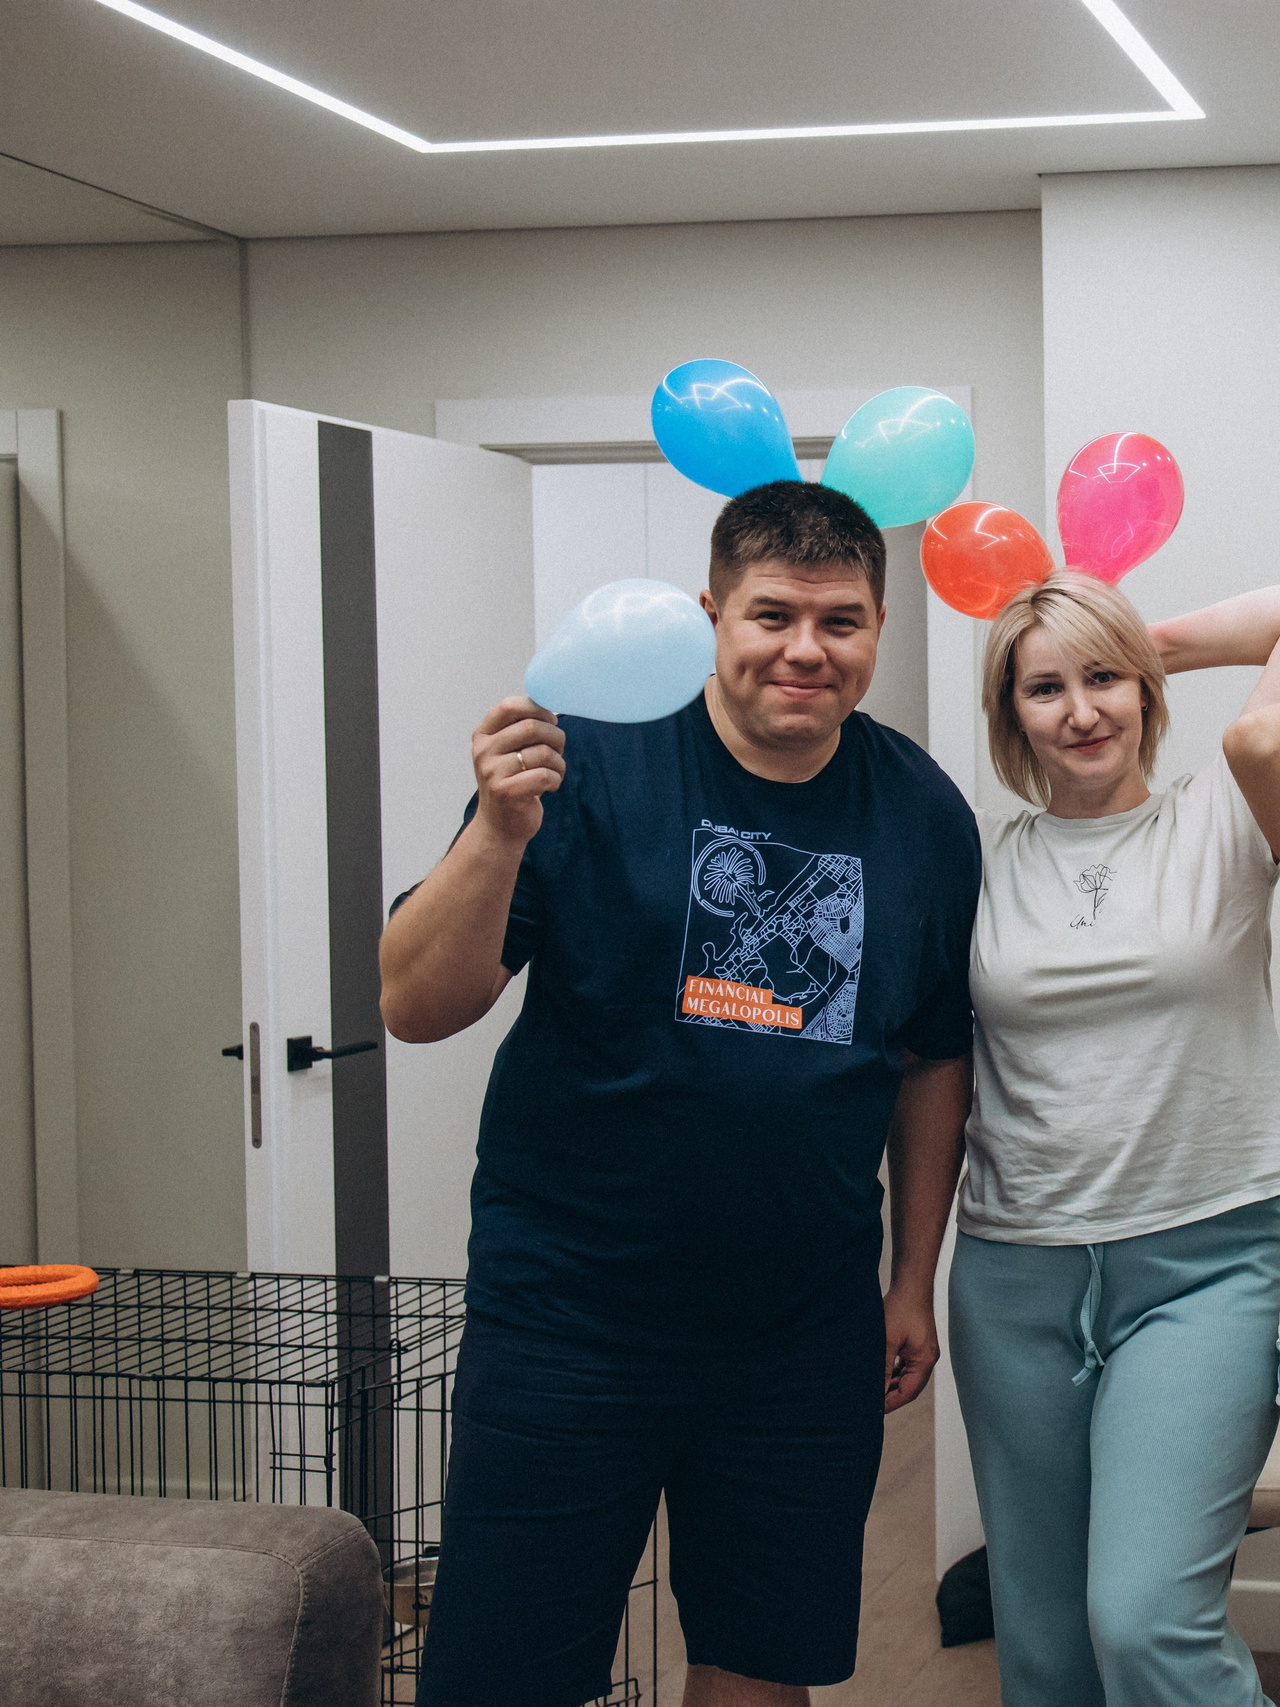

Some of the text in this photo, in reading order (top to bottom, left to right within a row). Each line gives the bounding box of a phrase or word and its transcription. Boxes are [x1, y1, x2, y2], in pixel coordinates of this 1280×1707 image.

[740, 831, 772, 840] CITY
[689, 979, 768, 1005] FINANCIAL
[686, 996, 800, 1026] MEGALOPOLIS
